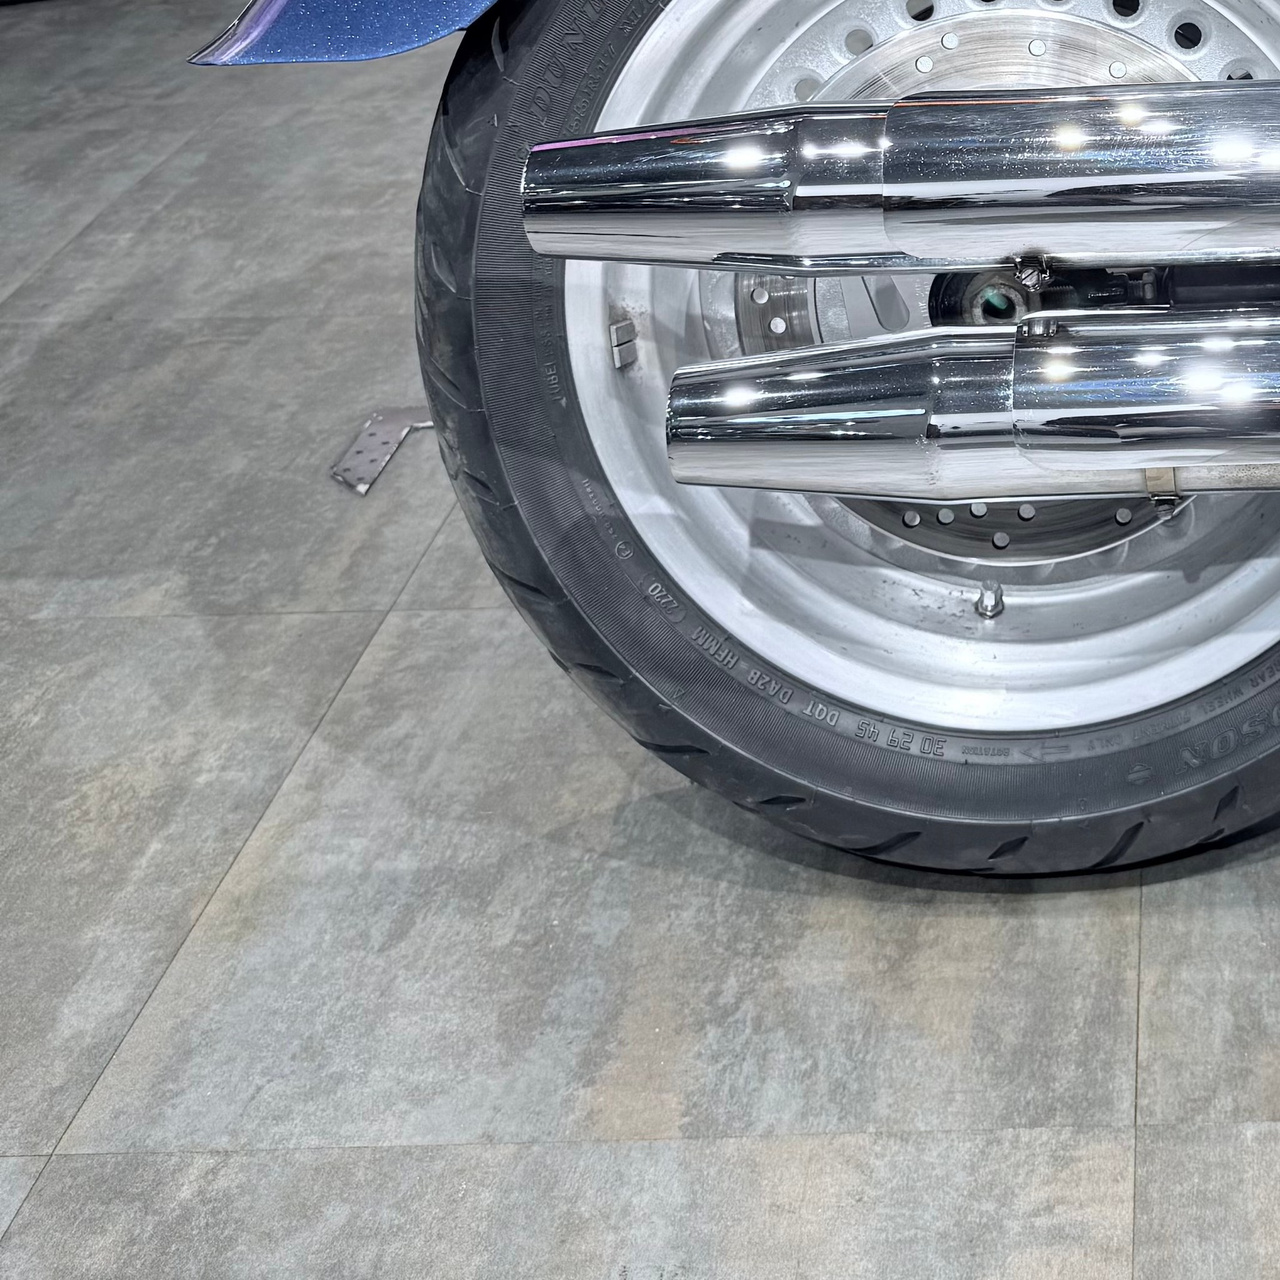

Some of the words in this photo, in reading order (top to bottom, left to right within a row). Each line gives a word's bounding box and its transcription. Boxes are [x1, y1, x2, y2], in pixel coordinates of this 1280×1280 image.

[648, 582, 679, 614] 2220
[746, 668, 794, 705] DA2B
[854, 719, 880, 743] 45
[886, 727, 914, 752] 29
[920, 735, 948, 757] 30
